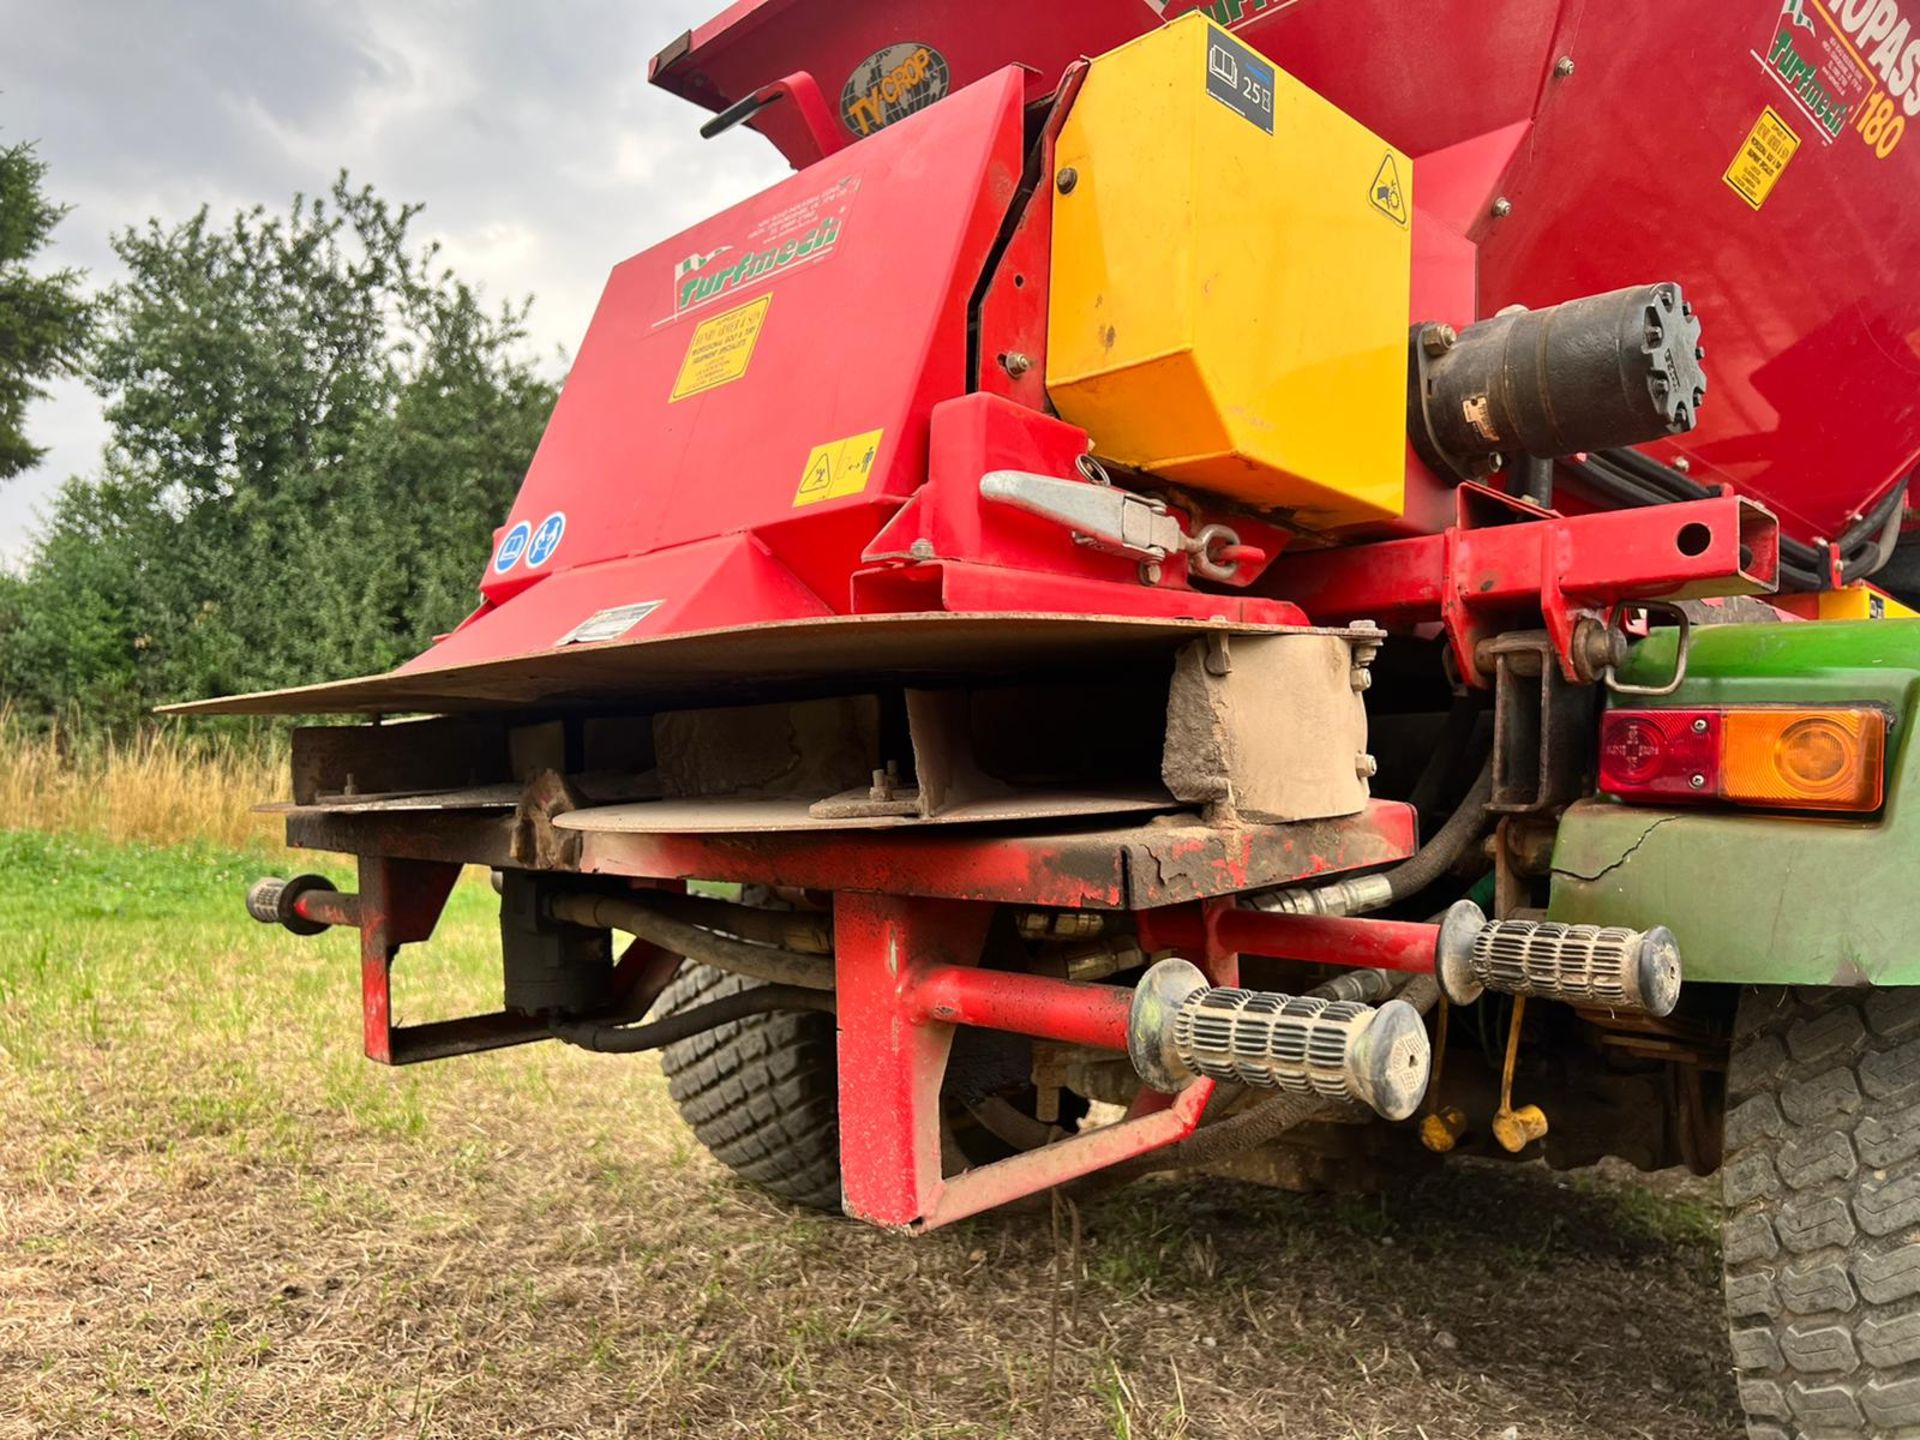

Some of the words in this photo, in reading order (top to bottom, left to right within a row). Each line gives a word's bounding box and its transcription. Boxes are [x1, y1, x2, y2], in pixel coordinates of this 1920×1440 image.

[1242, 76, 1261, 105] 25
[1855, 91, 1905, 160] 180
[679, 216, 842, 310] Turfmech
